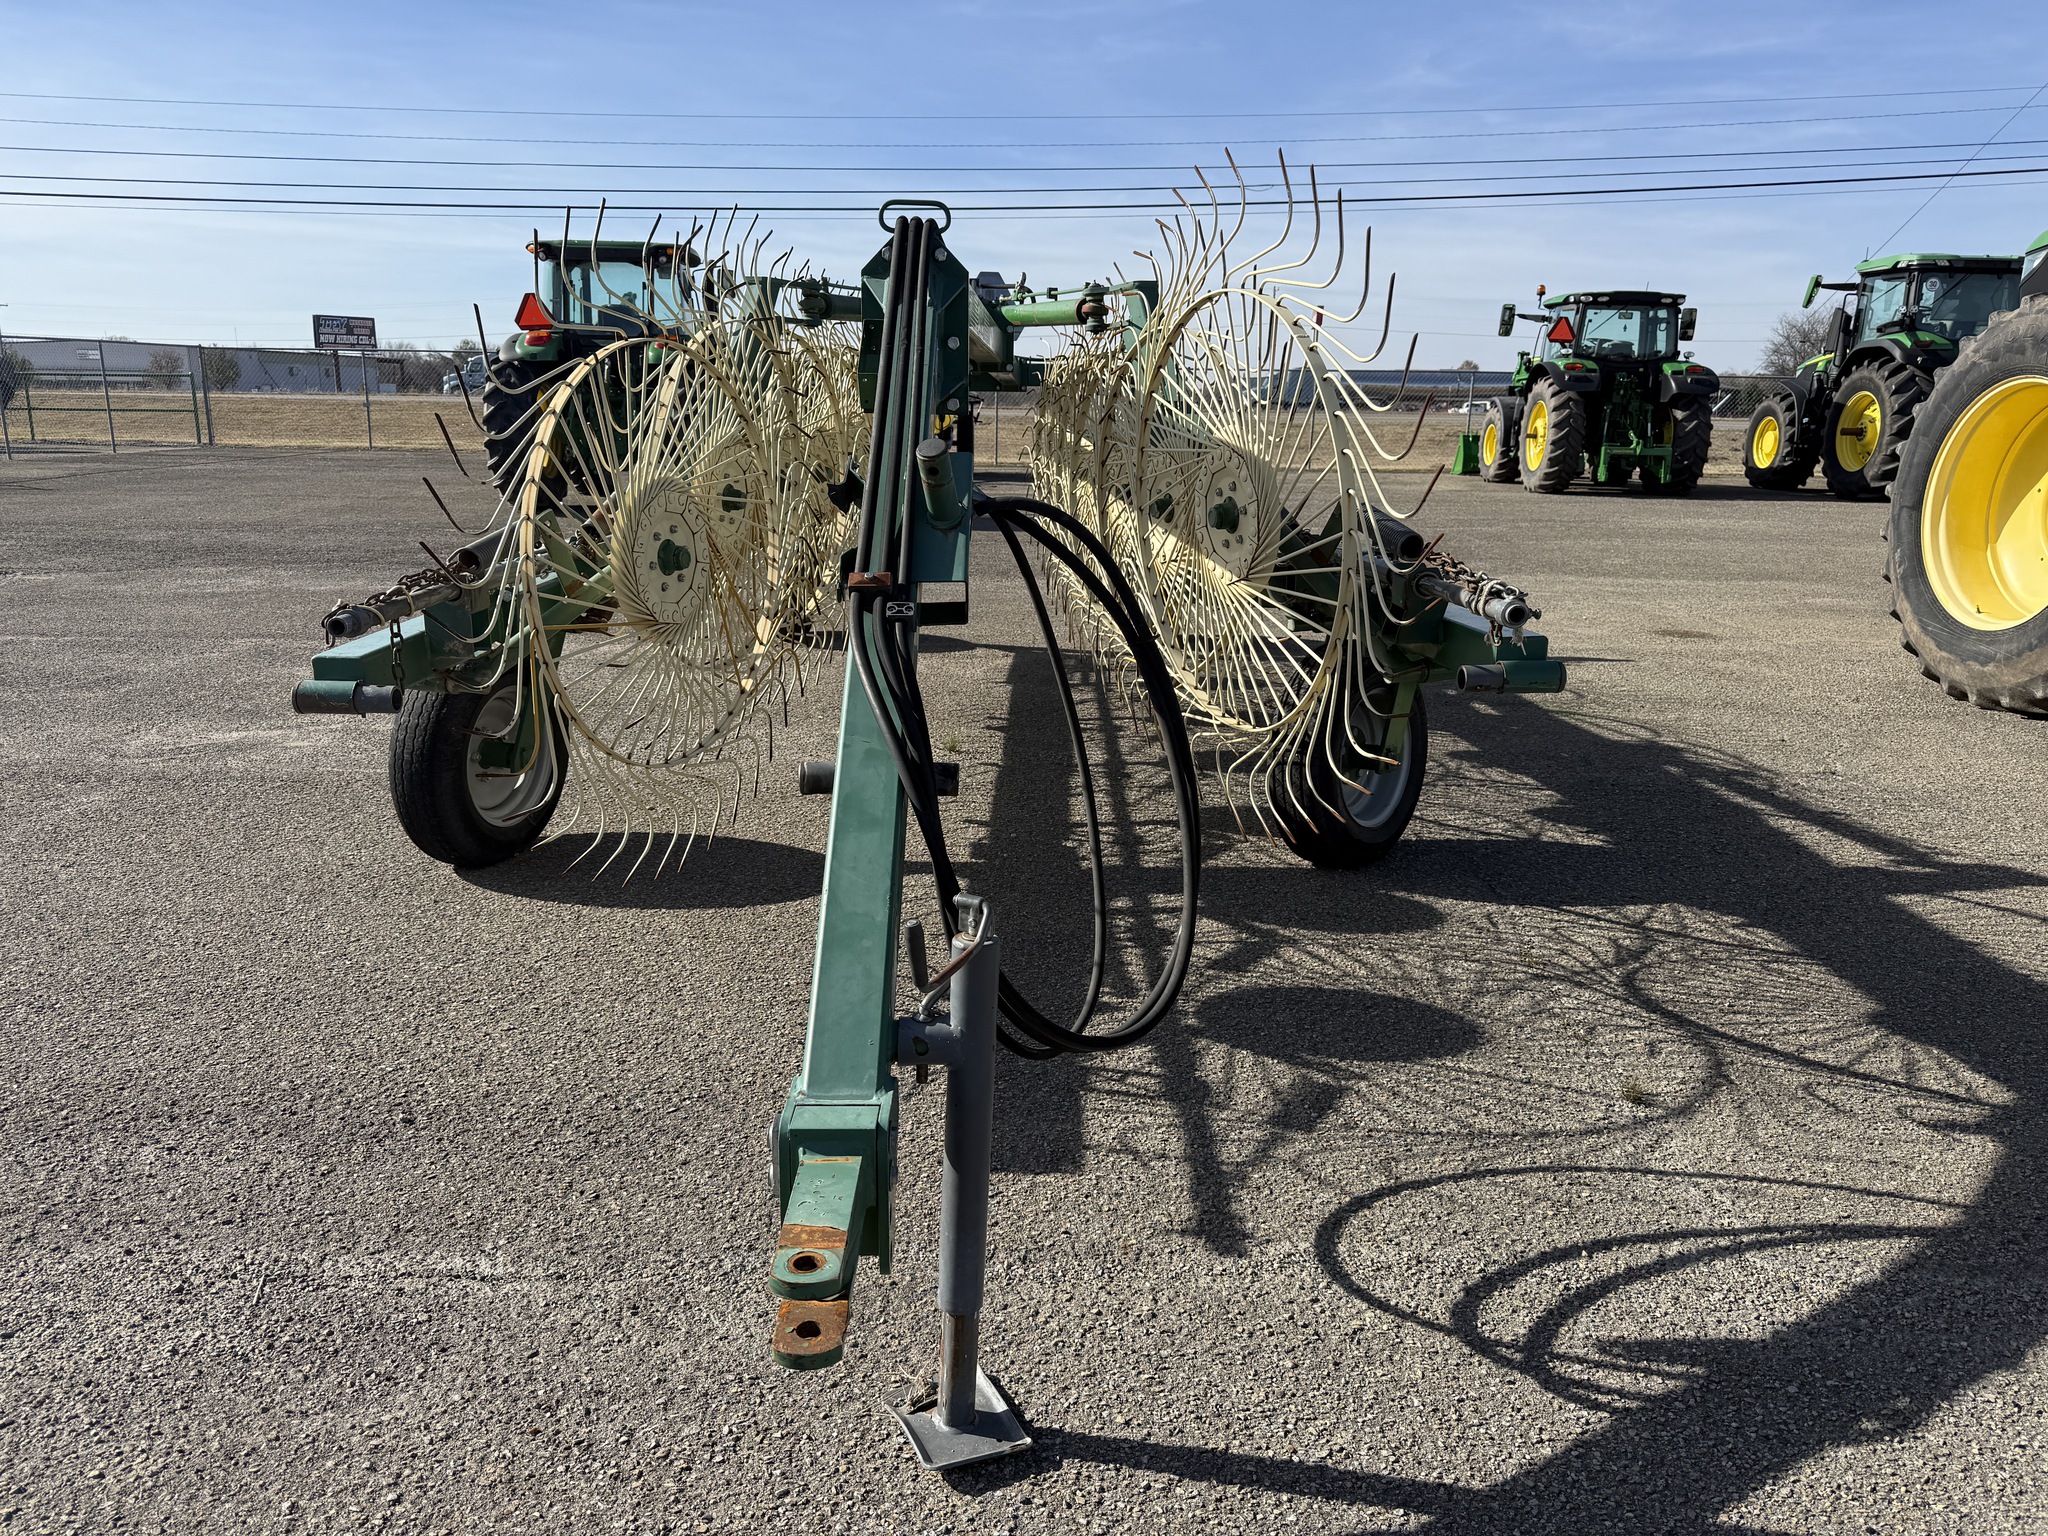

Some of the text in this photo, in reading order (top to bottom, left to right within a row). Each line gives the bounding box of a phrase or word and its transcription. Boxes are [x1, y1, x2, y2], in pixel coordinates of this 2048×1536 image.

[1928, 280, 1938, 288] 30
[319, 334, 375, 344] NOW HIRING CDL-A
